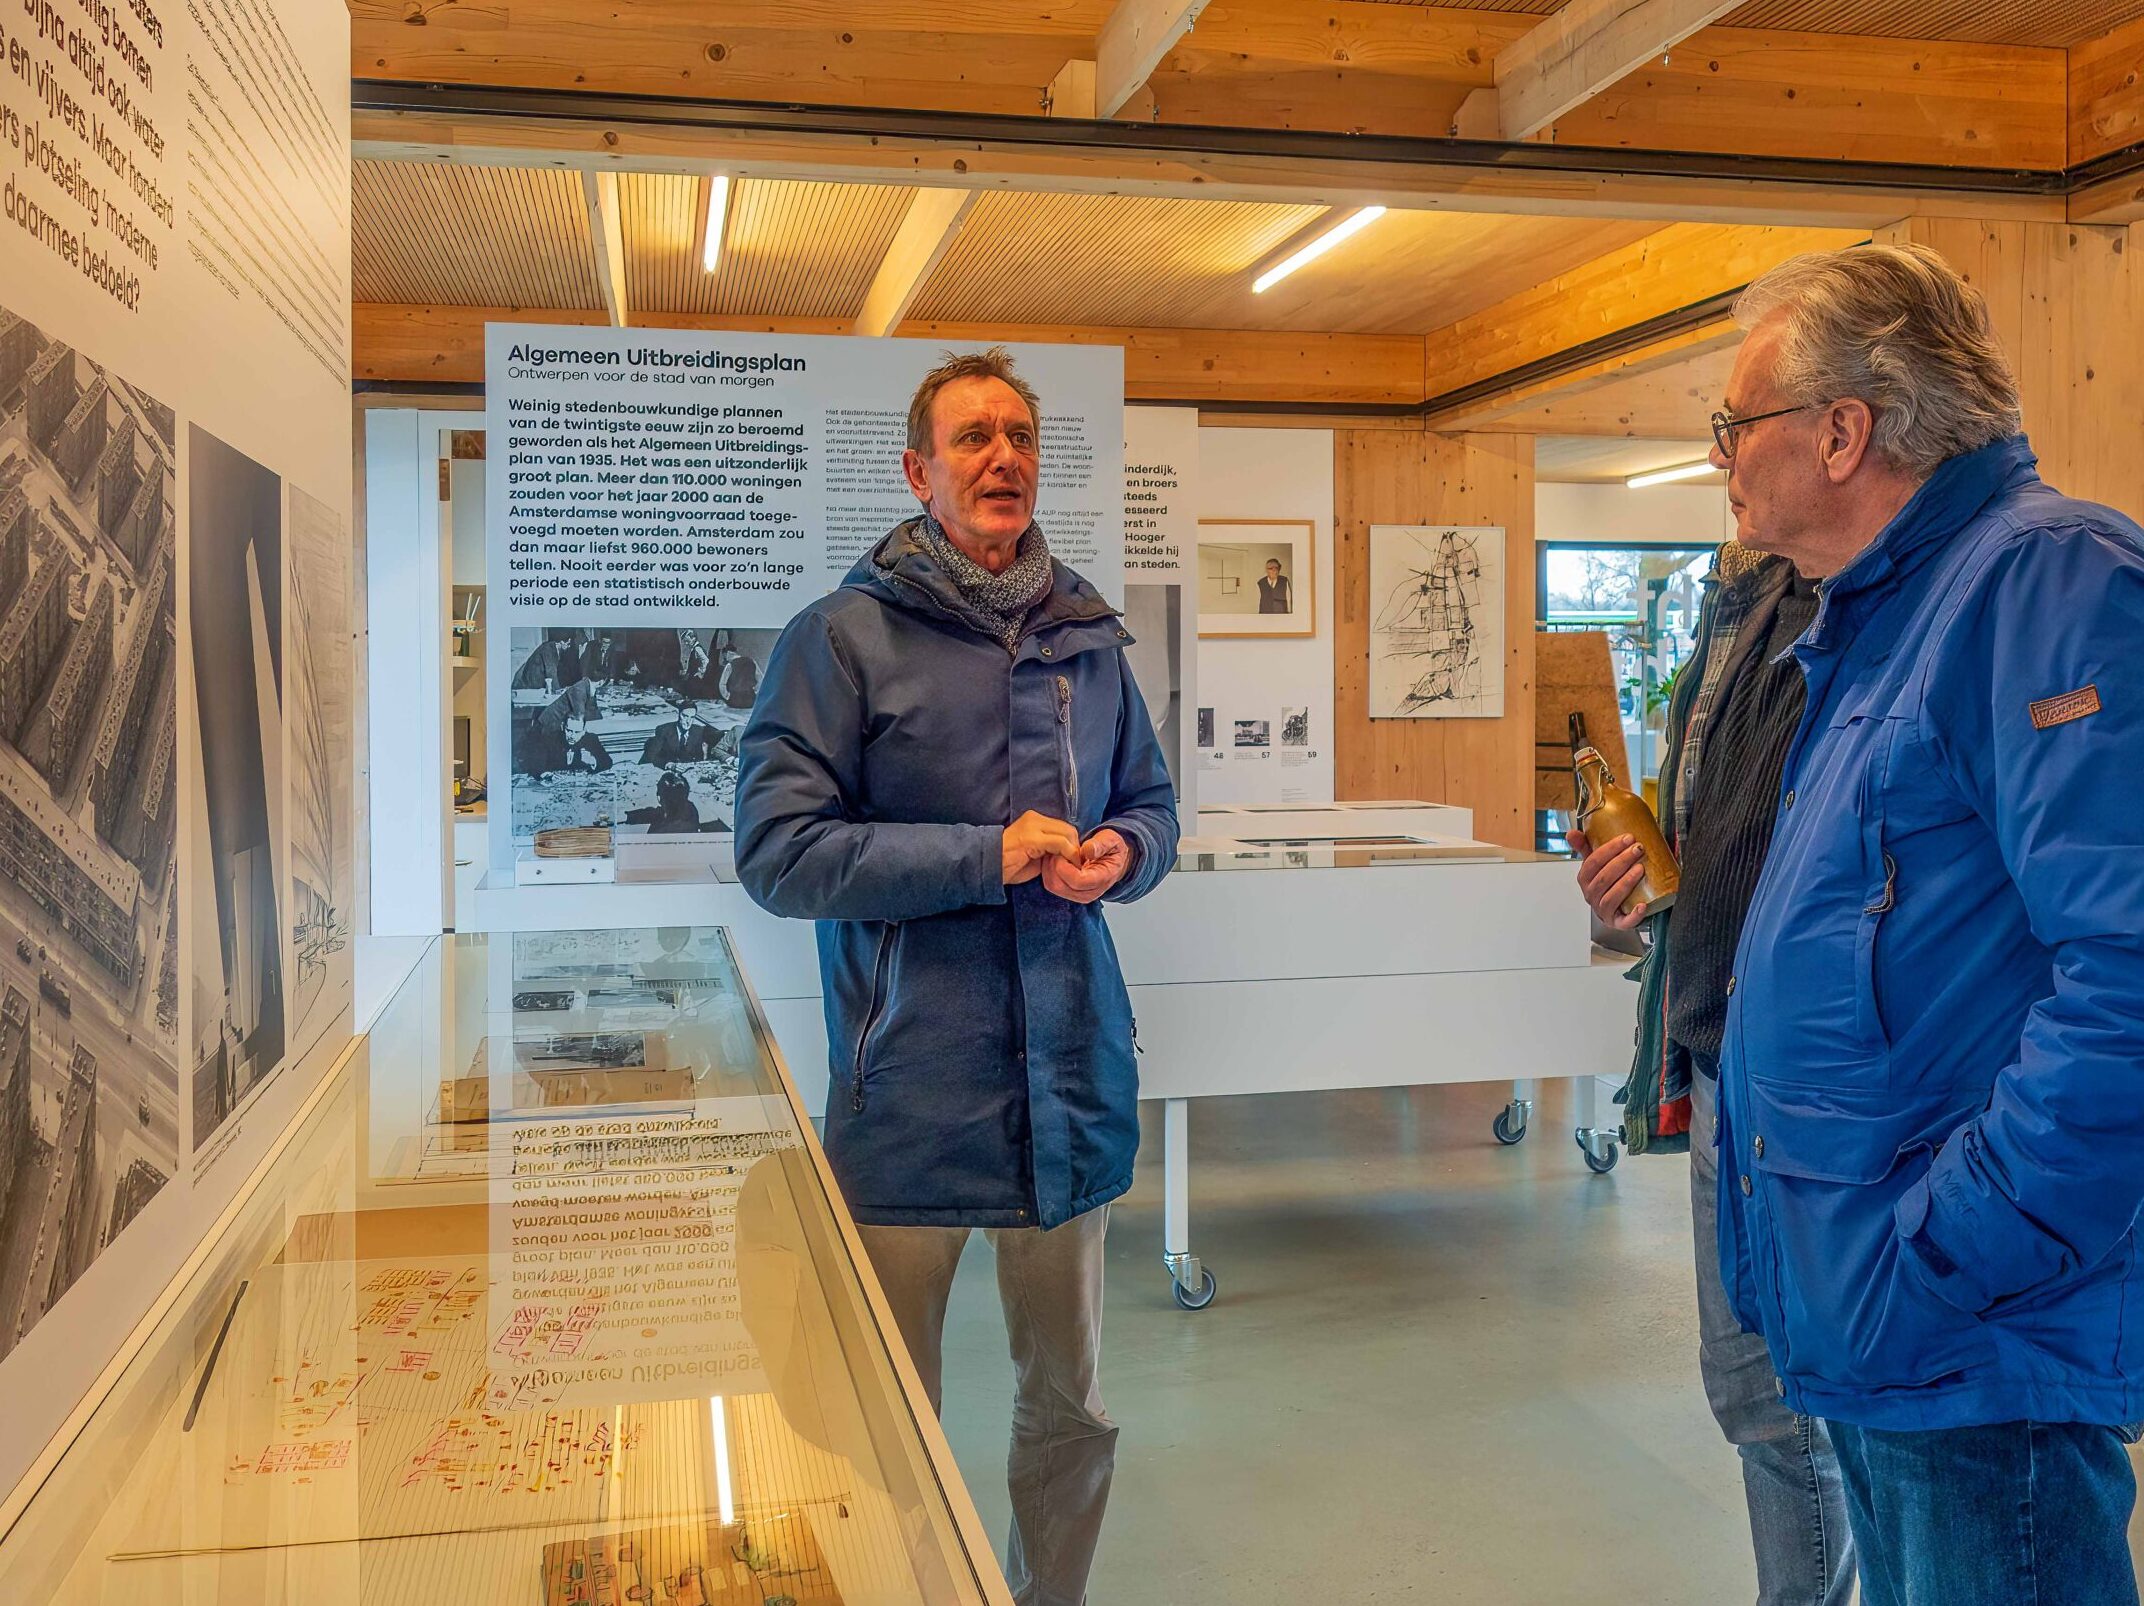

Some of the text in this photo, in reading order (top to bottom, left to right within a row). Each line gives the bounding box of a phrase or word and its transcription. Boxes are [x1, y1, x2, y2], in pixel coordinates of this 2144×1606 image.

[113, 8, 153, 93] bomen
[69, 28, 105, 96] altijd
[108, 78, 130, 126] ook
[132, 106, 165, 162] water
[10, 37, 31, 87] en
[35, 60, 89, 144] vijvers.
[93, 113, 126, 180] Maar
[129, 150, 174, 229] honderd
[25, 121, 99, 227] plotseling
[5, 172, 140, 313] daarmee bedoeld?
[508, 344, 805, 373] Algemeen Uitbreidingsplan
[508, 367, 774, 388] Ontwerpen voor de stad van morgen
[509, 399, 782, 419] Weinig stedenbouwkundige plannen
[509, 417, 803, 436] van de twintigste eeuw zijn zo beroemd
[509, 435, 808, 455] geworden als het Algemeen Uitbreidings-
[509, 452, 807, 472] plan van 1935. Het was een uitzonderlijk
[509, 471, 801, 489] groot plan. Meer dan 110.000 woningen
[1143, 478, 1178, 488] broers
[509, 488, 763, 503] zouden voor het jaar 2000 aan de
[509, 506, 797, 523] Amsterdamse woningvoorraad toege-
[1147, 519, 1156, 527] in
[510, 523, 804, 538] voegd moeten worden. Amsterdam zou
[1125, 533, 1166, 543] Hooger
[510, 540, 768, 555] dan maar liefst 960.000 bewoners
[1166, 546, 1179, 557] hij
[509, 558, 803, 575] tellen. Nooit eerder was voor zo'n lange
[1141, 560, 1180, 568] steden.
[510, 576, 790, 590] periode een statistisch onderbouwde
[510, 594, 719, 608] visie op de stad ontwikkeld.
